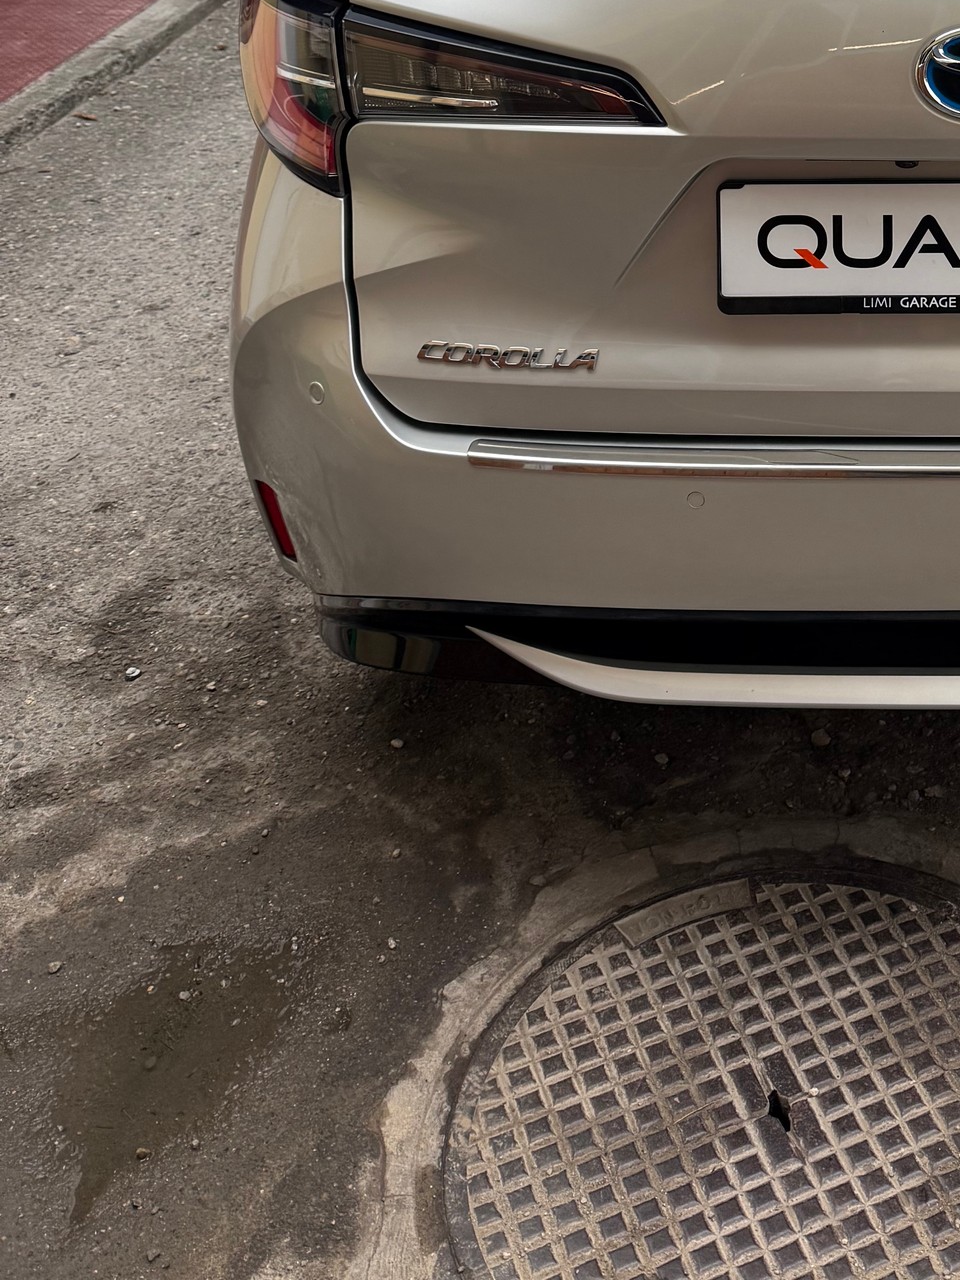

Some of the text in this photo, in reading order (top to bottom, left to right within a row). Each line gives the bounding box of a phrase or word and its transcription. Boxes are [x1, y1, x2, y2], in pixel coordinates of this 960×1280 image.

[863, 297, 892, 308] LIMI
[900, 297, 957, 308] GARAGE
[417, 340, 600, 370] COROLLA
